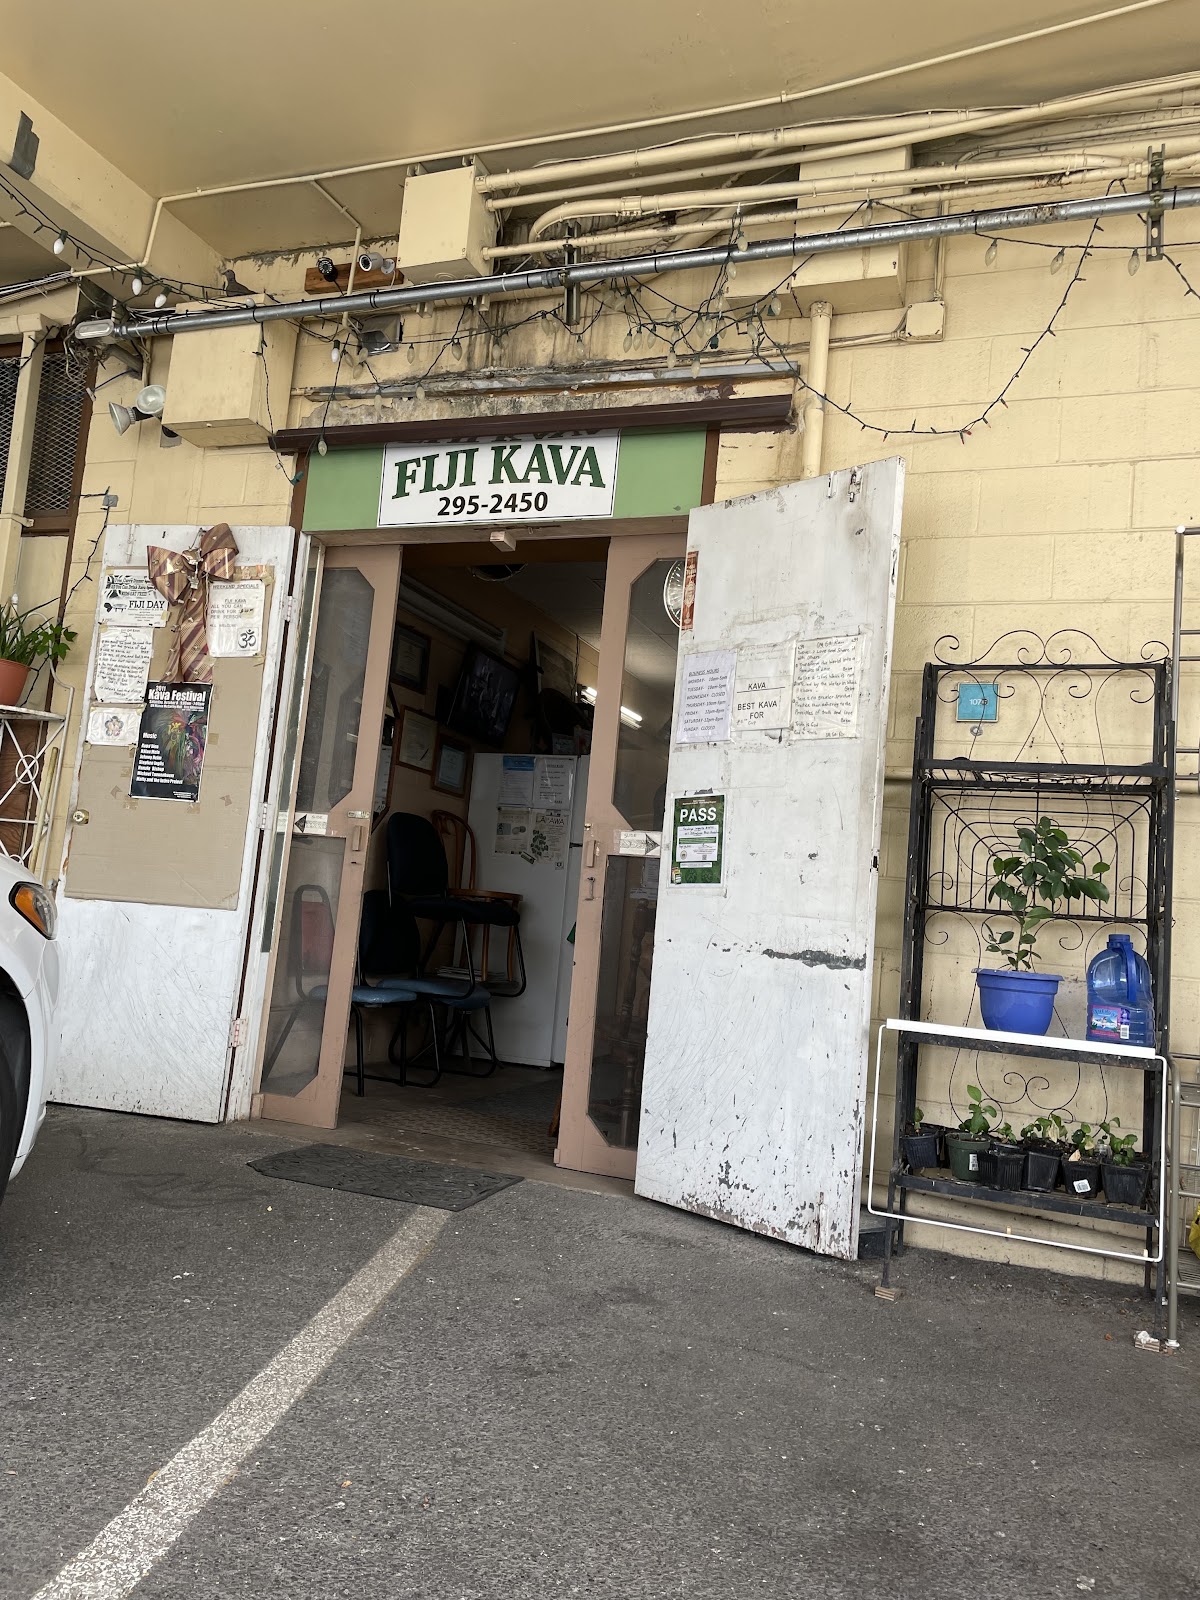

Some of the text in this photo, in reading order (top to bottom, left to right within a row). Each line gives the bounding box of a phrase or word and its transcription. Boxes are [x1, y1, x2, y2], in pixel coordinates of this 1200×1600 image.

[392, 444, 606, 499] FIJI KAVA
[437, 492, 548, 515] 295-2450
[129, 600, 166, 609] FIJI DAY
[748, 682, 767, 691] KAVA
[148, 688, 171, 701] Kava
[172, 689, 207, 702] Festival
[737, 700, 778, 711] BEST KAVA
[750, 711, 765, 720] FOR
[680, 806, 717, 823] PASS
